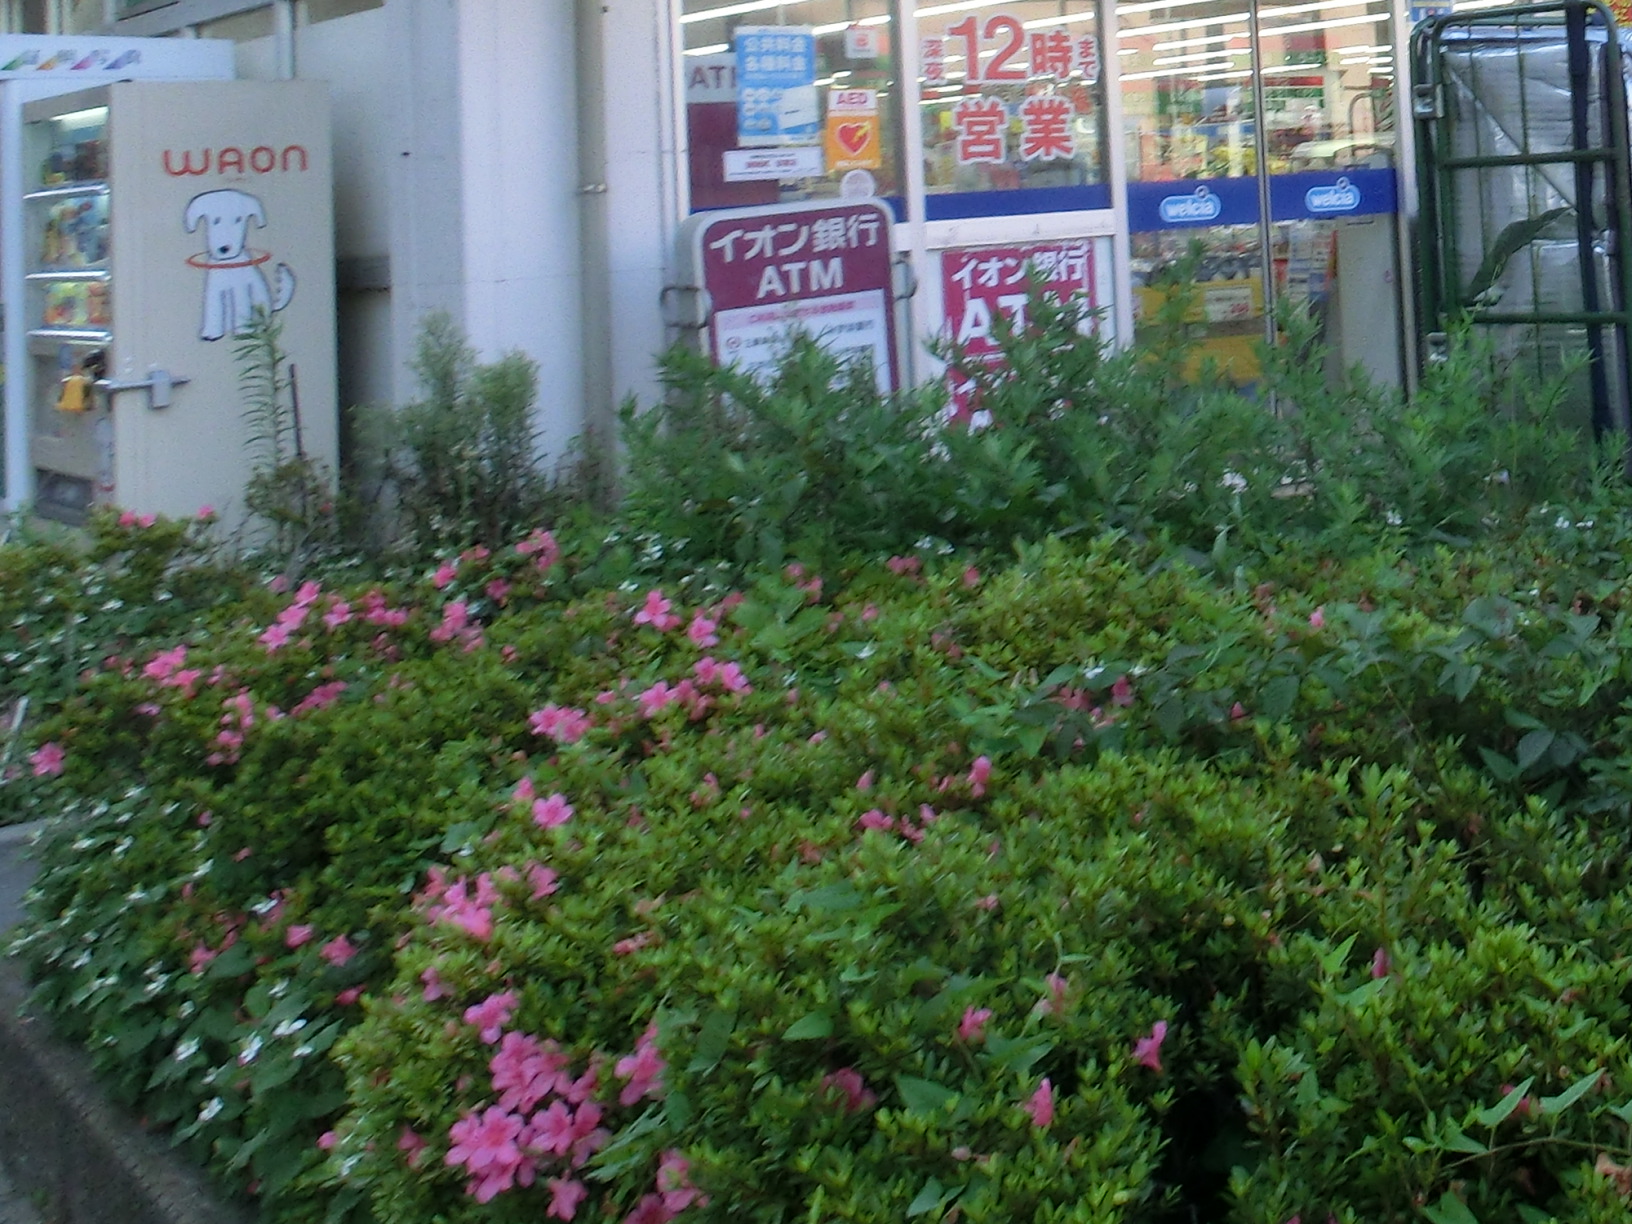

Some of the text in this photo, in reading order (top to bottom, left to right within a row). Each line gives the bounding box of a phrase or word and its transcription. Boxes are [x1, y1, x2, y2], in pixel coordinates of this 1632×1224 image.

[836, 92, 869, 105] AED
[956, 99, 1074, 161] 営業
[163, 145, 309, 177] WAON
[1164, 189, 1217, 218] welcia
[1310, 181, 1356, 207] welcia
[709, 212, 881, 264] イオン銀行
[757, 257, 845, 299] ATM
